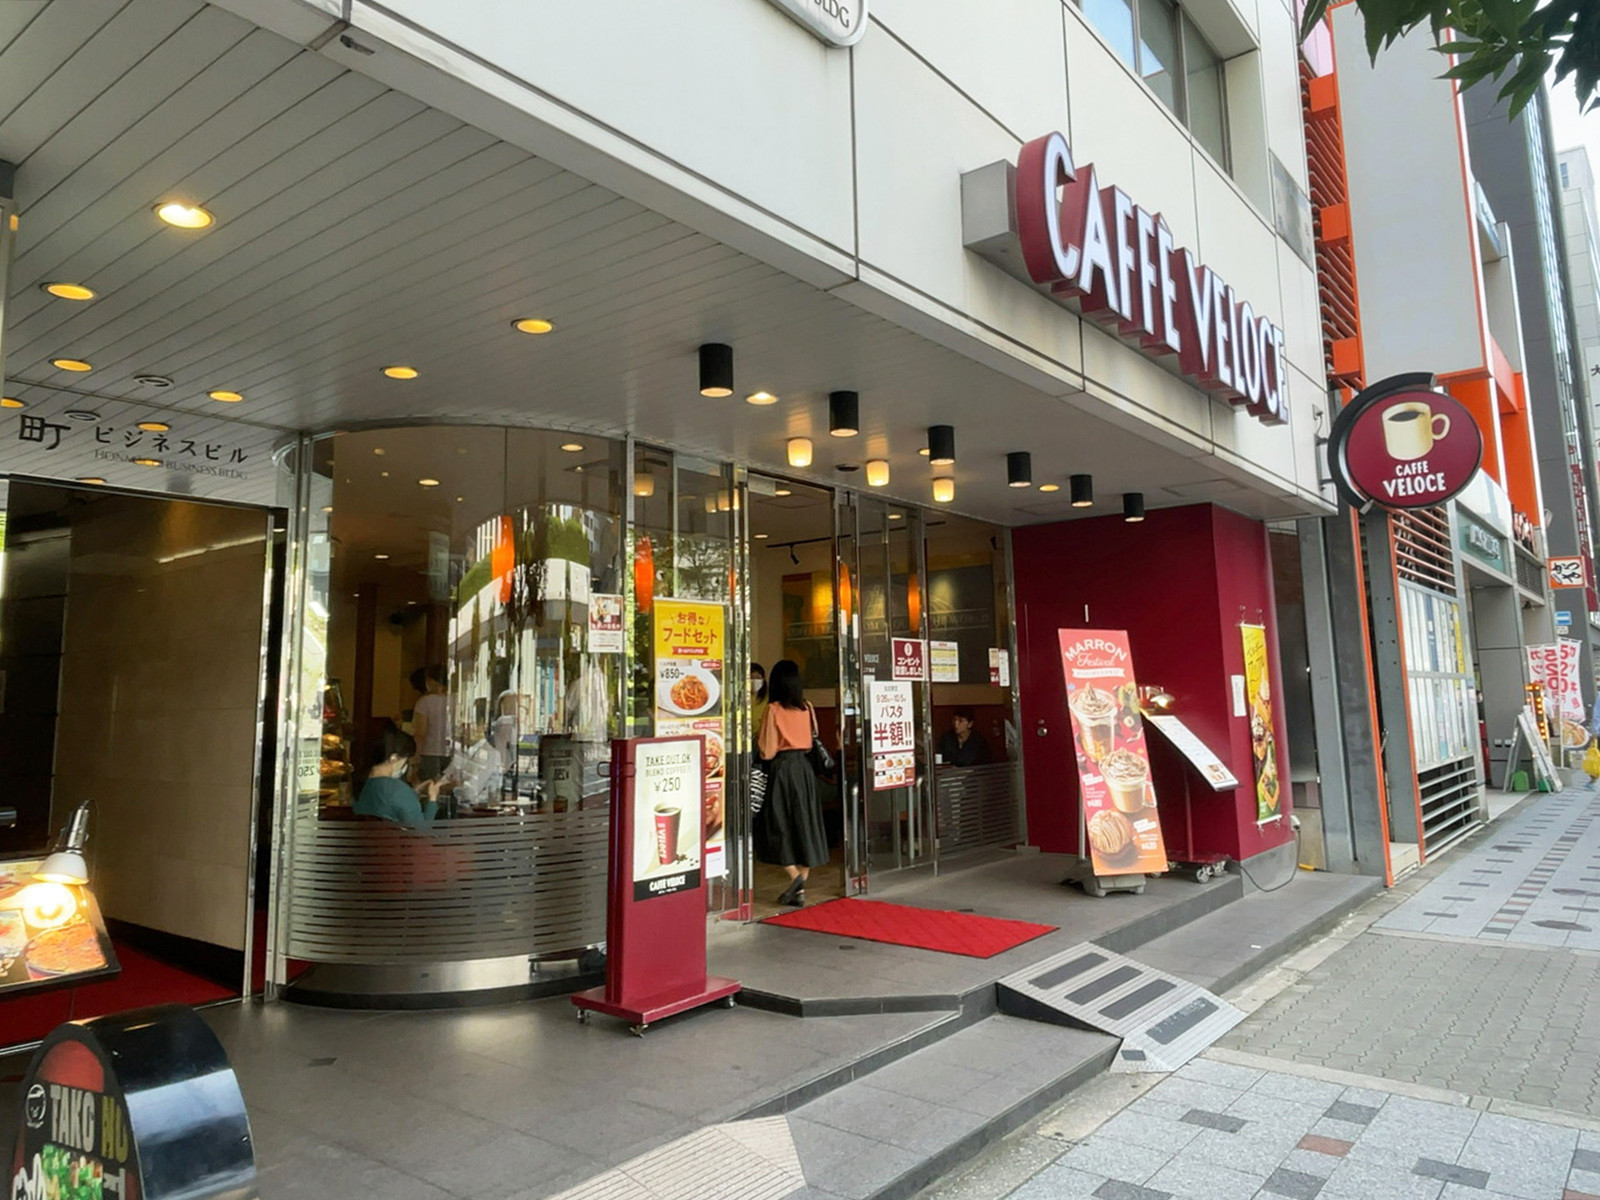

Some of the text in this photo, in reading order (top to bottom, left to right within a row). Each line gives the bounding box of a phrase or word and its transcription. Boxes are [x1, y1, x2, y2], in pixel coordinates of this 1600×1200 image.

[1184, 249, 1289, 425] VELOCE
[95, 426, 249, 464] ビジネスビル
[1382, 473, 1446, 498] VELOCE
[662, 627, 717, 645] フードセット
[1064, 638, 1127, 662] MARRON
[897, 656, 921, 666] コンセント
[880, 705, 904, 719] パスタ
[646, 756, 665, 767] TAKE
[654, 776, 681, 793] ¥250
[50, 1084, 95, 1153] TAKO
